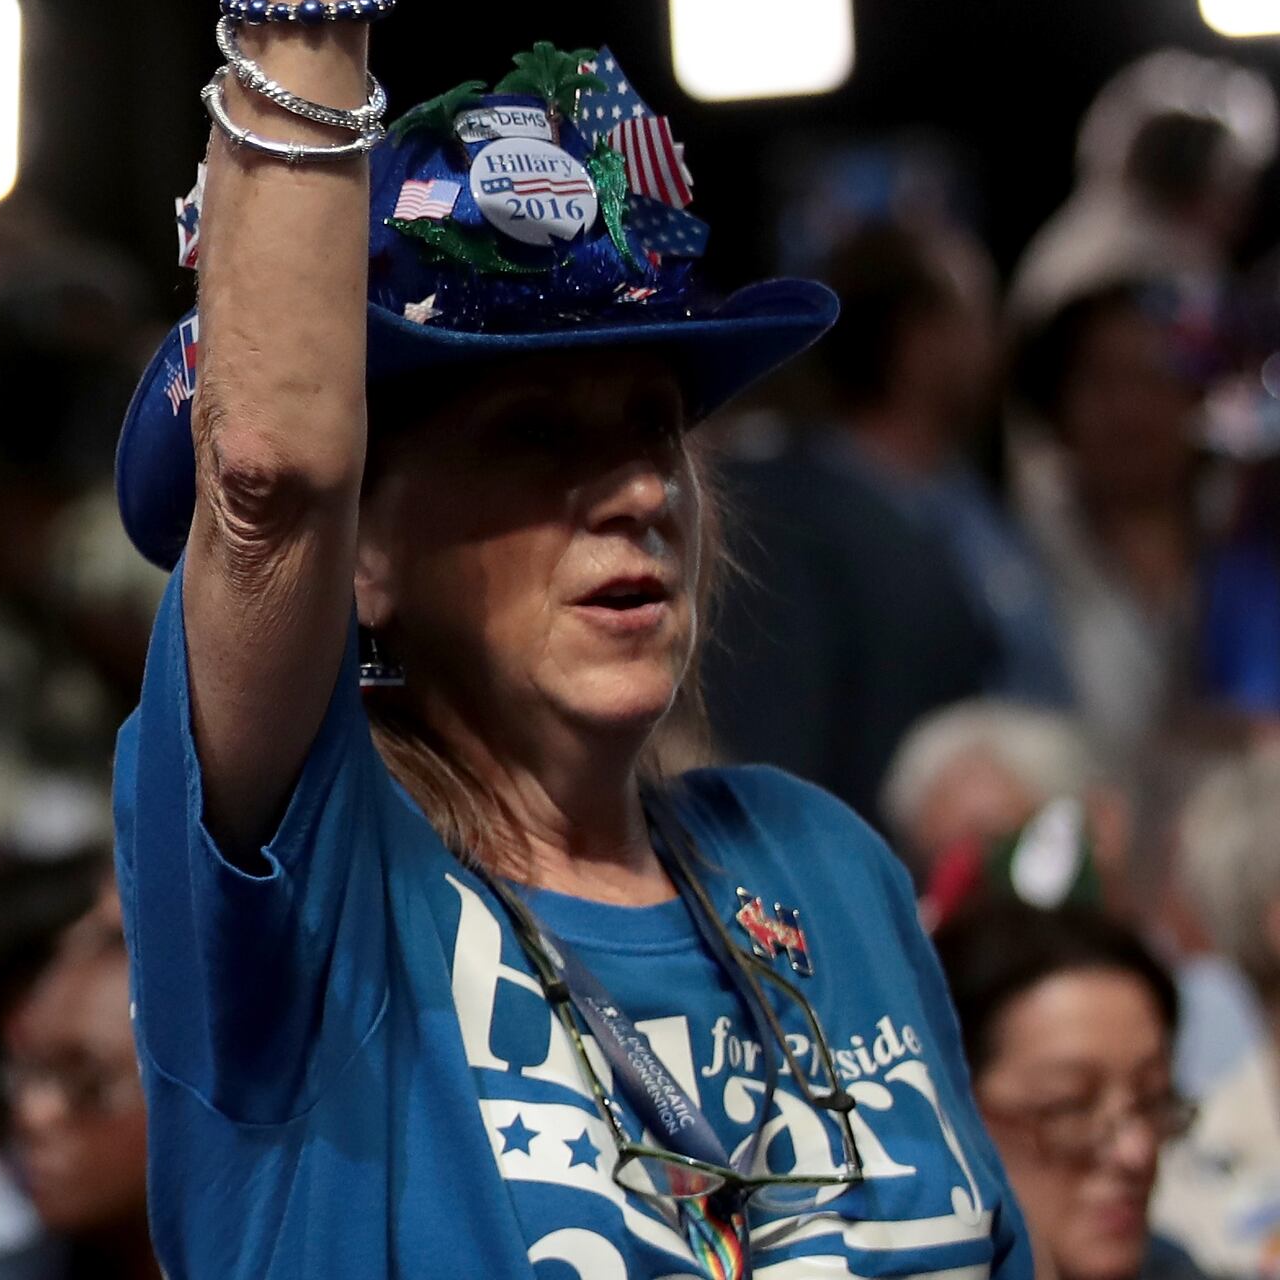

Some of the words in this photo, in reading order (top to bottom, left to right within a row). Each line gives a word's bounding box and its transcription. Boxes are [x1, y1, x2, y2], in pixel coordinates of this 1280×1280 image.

[497, 111, 547, 128] DEMS
[484, 154, 574, 177] Hillary
[505, 196, 585, 222] 2016
[701, 1015, 762, 1078] for
[626, 1051, 679, 1136] CONVENTION
[628, 1036, 696, 1129] DEMOCRATIC
